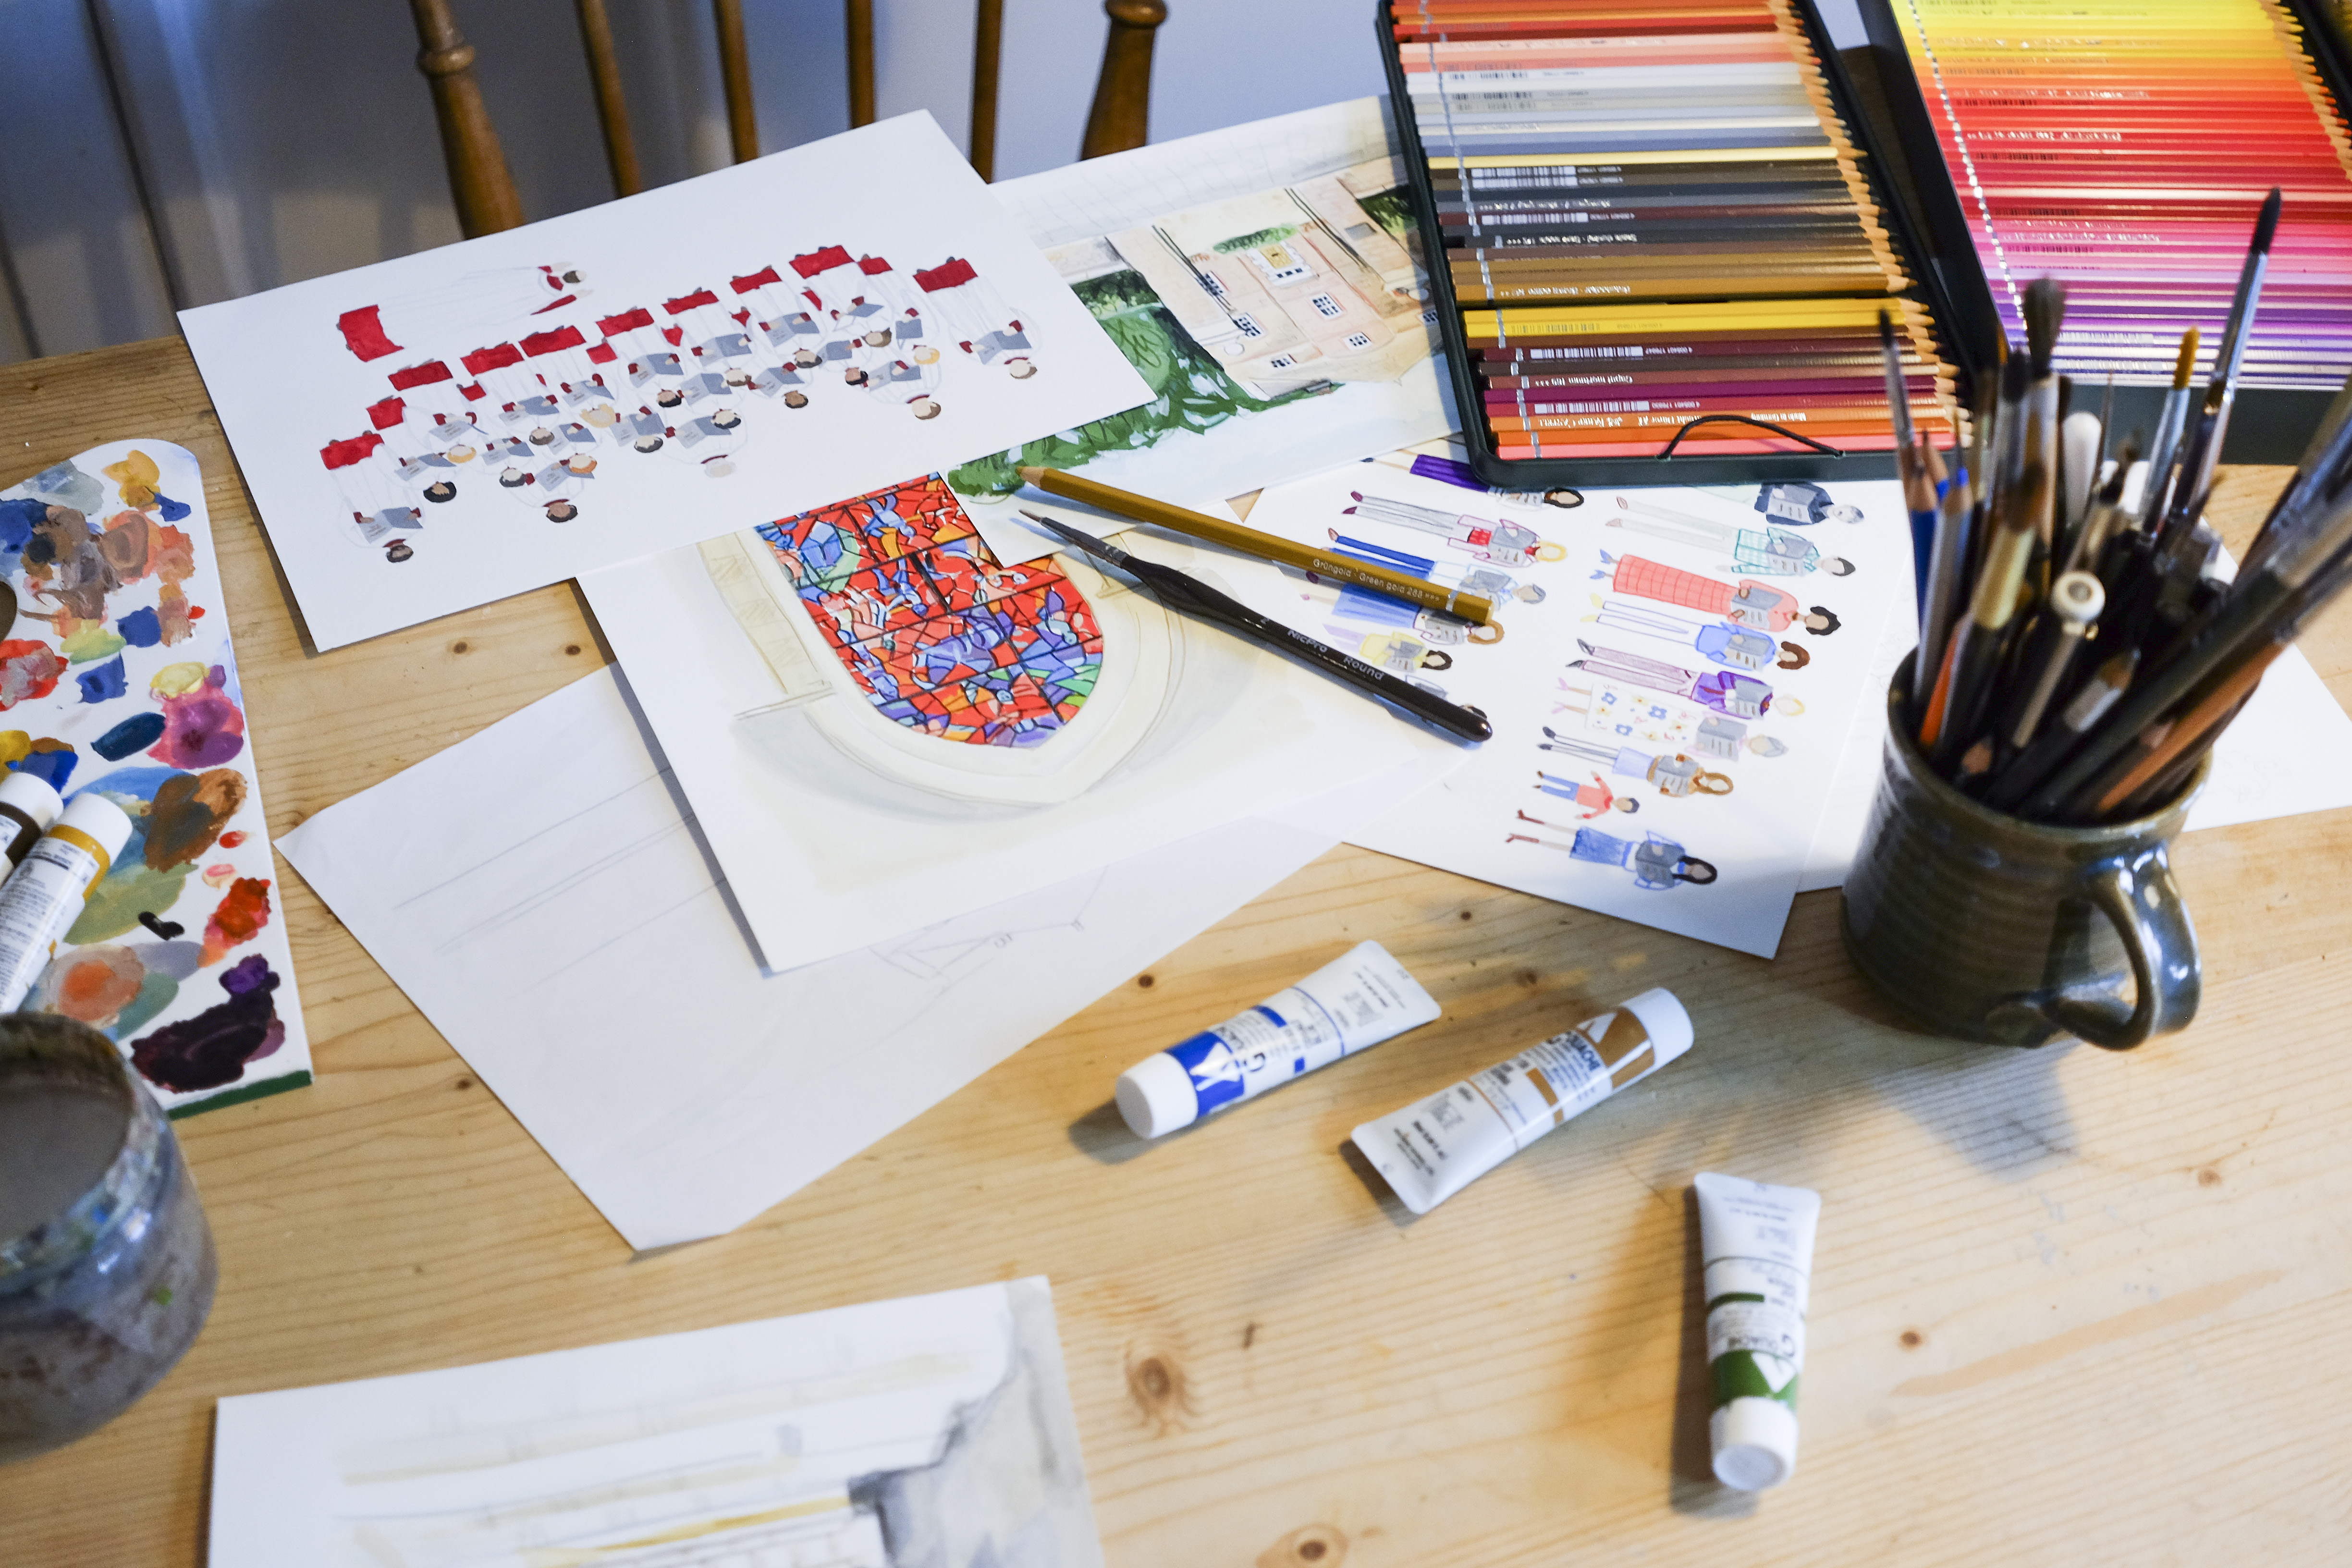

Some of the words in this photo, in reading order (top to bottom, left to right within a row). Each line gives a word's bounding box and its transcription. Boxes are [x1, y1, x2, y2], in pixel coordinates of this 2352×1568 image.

[1780, 413, 1787, 421] in
[1788, 412, 1806, 421] Made
[1313, 558, 1352, 577] Grüngold
[1359, 572, 1384, 587] Green
[1386, 581, 1405, 594] gold
[1287, 630, 1328, 653] NicPro
[1344, 656, 1385, 681] Round
